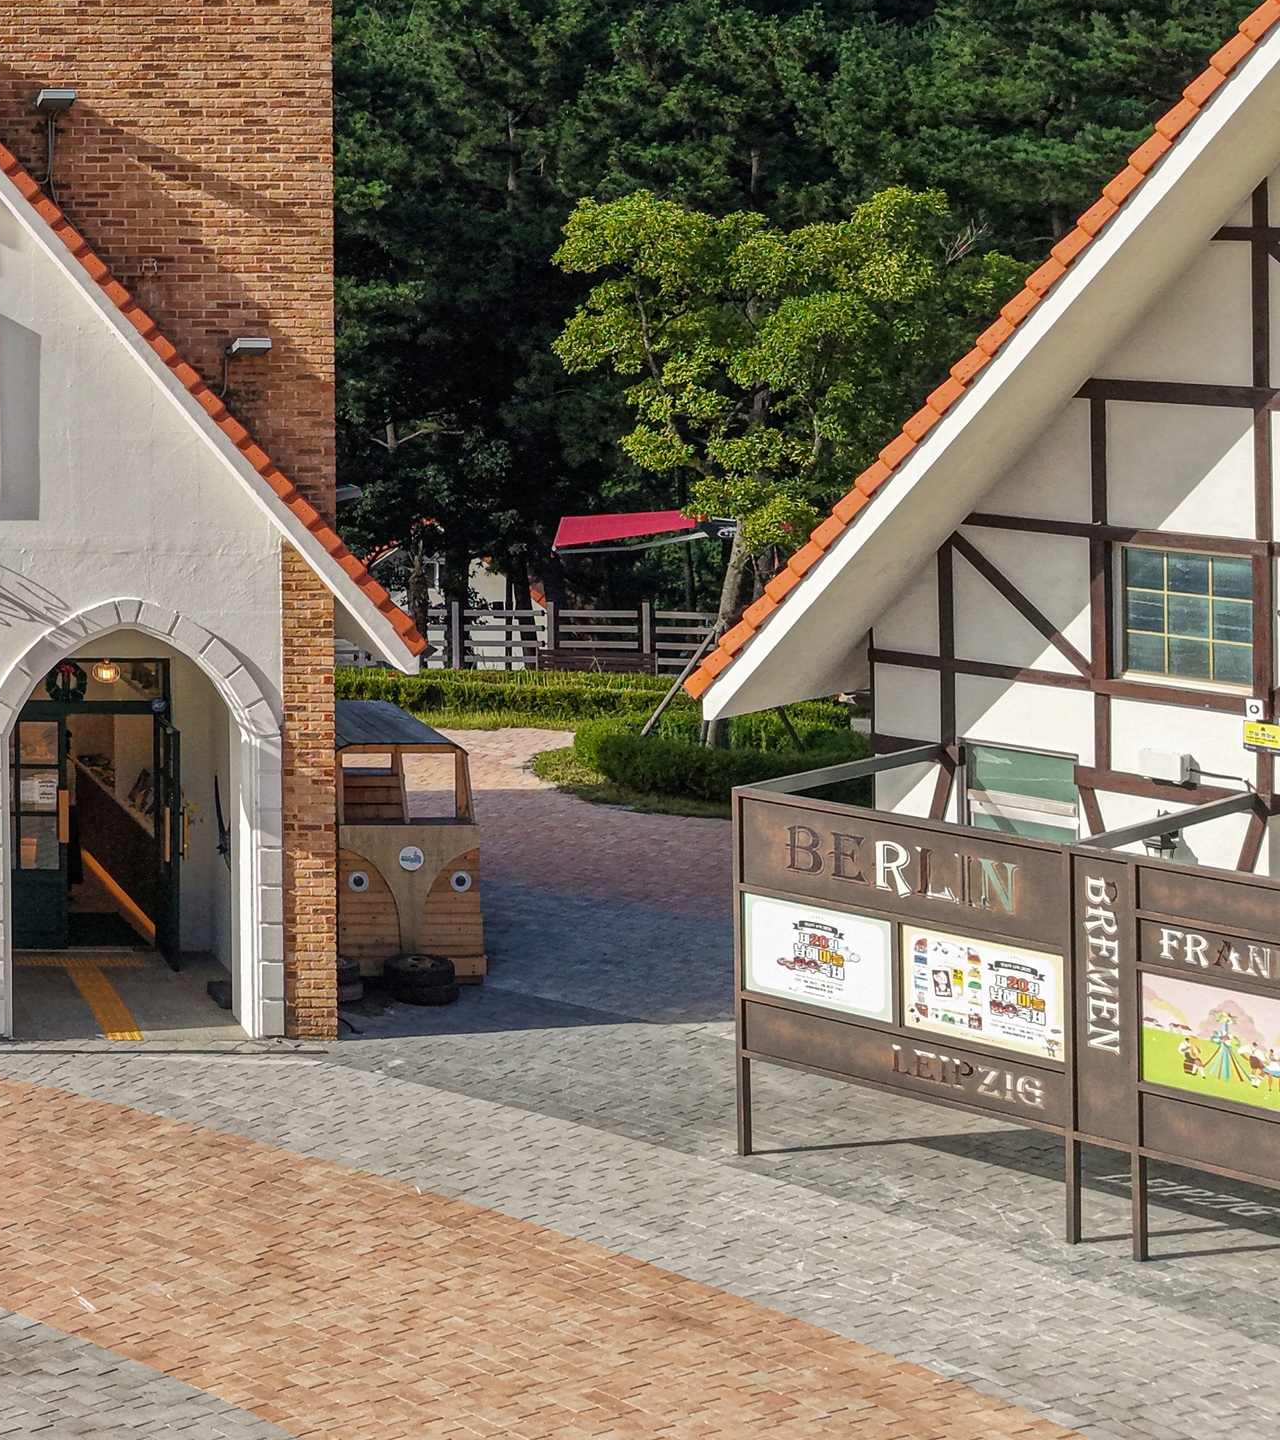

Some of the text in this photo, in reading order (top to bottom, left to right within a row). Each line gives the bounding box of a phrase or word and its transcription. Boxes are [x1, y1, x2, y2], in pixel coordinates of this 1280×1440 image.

[785, 825, 1020, 915] BERLIN
[799, 932, 840, 951] 제20회
[1083, 875, 1121, 1057] BREMEN
[995, 974, 1040, 995] 제20회
[891, 1044, 1046, 1110] LEIPZIG
